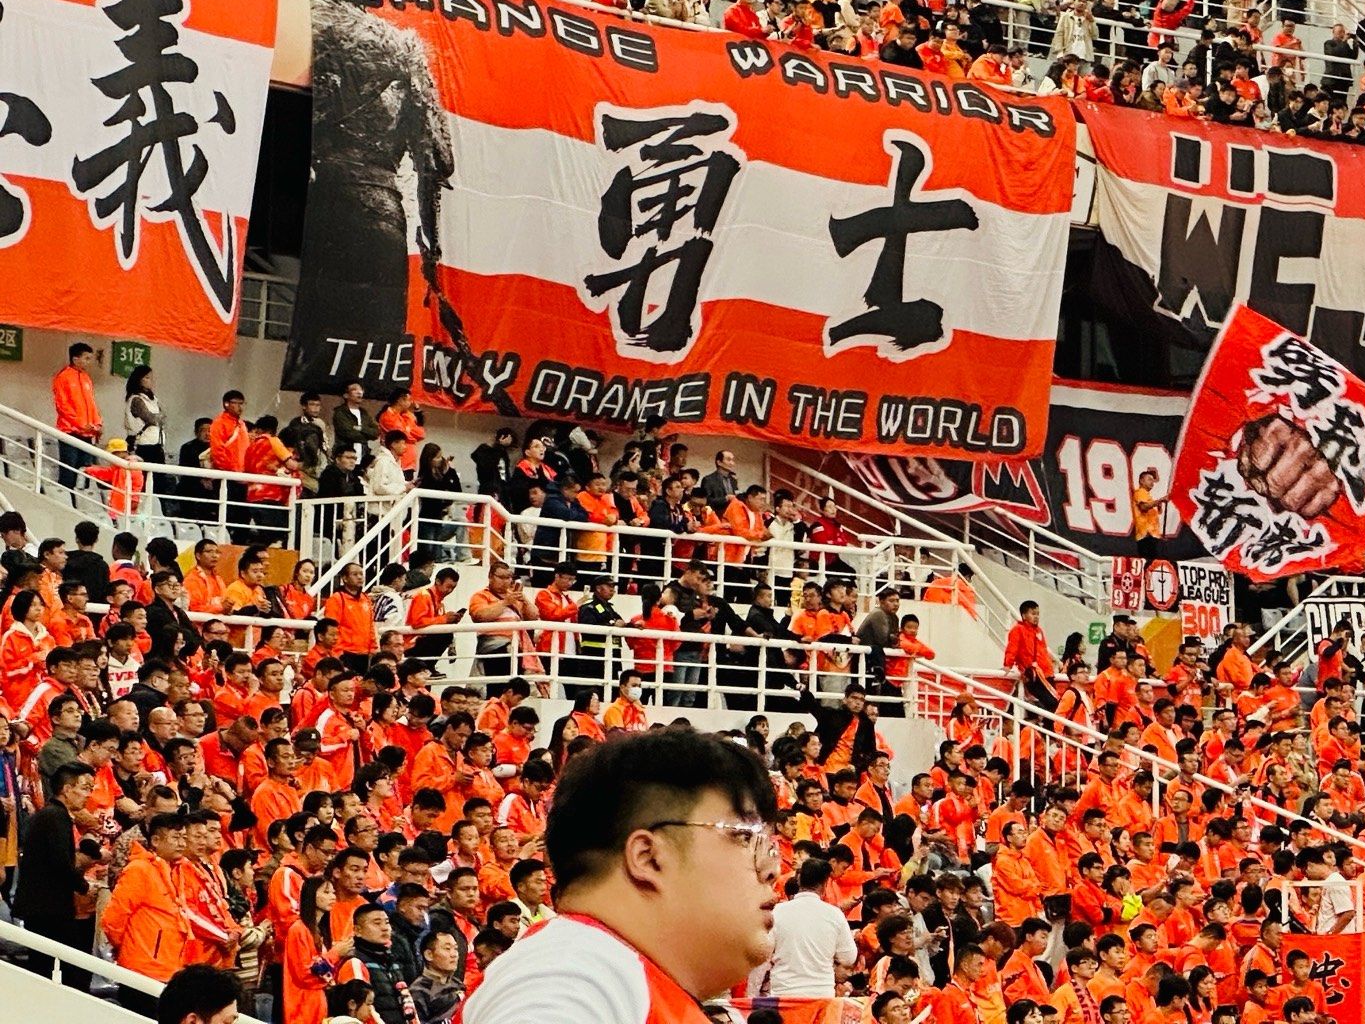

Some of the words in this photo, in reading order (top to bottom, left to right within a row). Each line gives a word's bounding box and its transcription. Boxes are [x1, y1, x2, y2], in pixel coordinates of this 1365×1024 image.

[726, 39, 1056, 138] WARRIOR
[583, 104, 980, 360] 勇士
[1154, 131, 1338, 338] WE
[120, 347, 145, 365] 31区
[325, 337, 414, 382] THE
[529, 366, 706, 422] ORANGE
[725, 378, 772, 422] IN
[792, 390, 865, 435] THE
[880, 402, 1020, 449] WORLD
[1180, 565, 1206, 586] TOP
